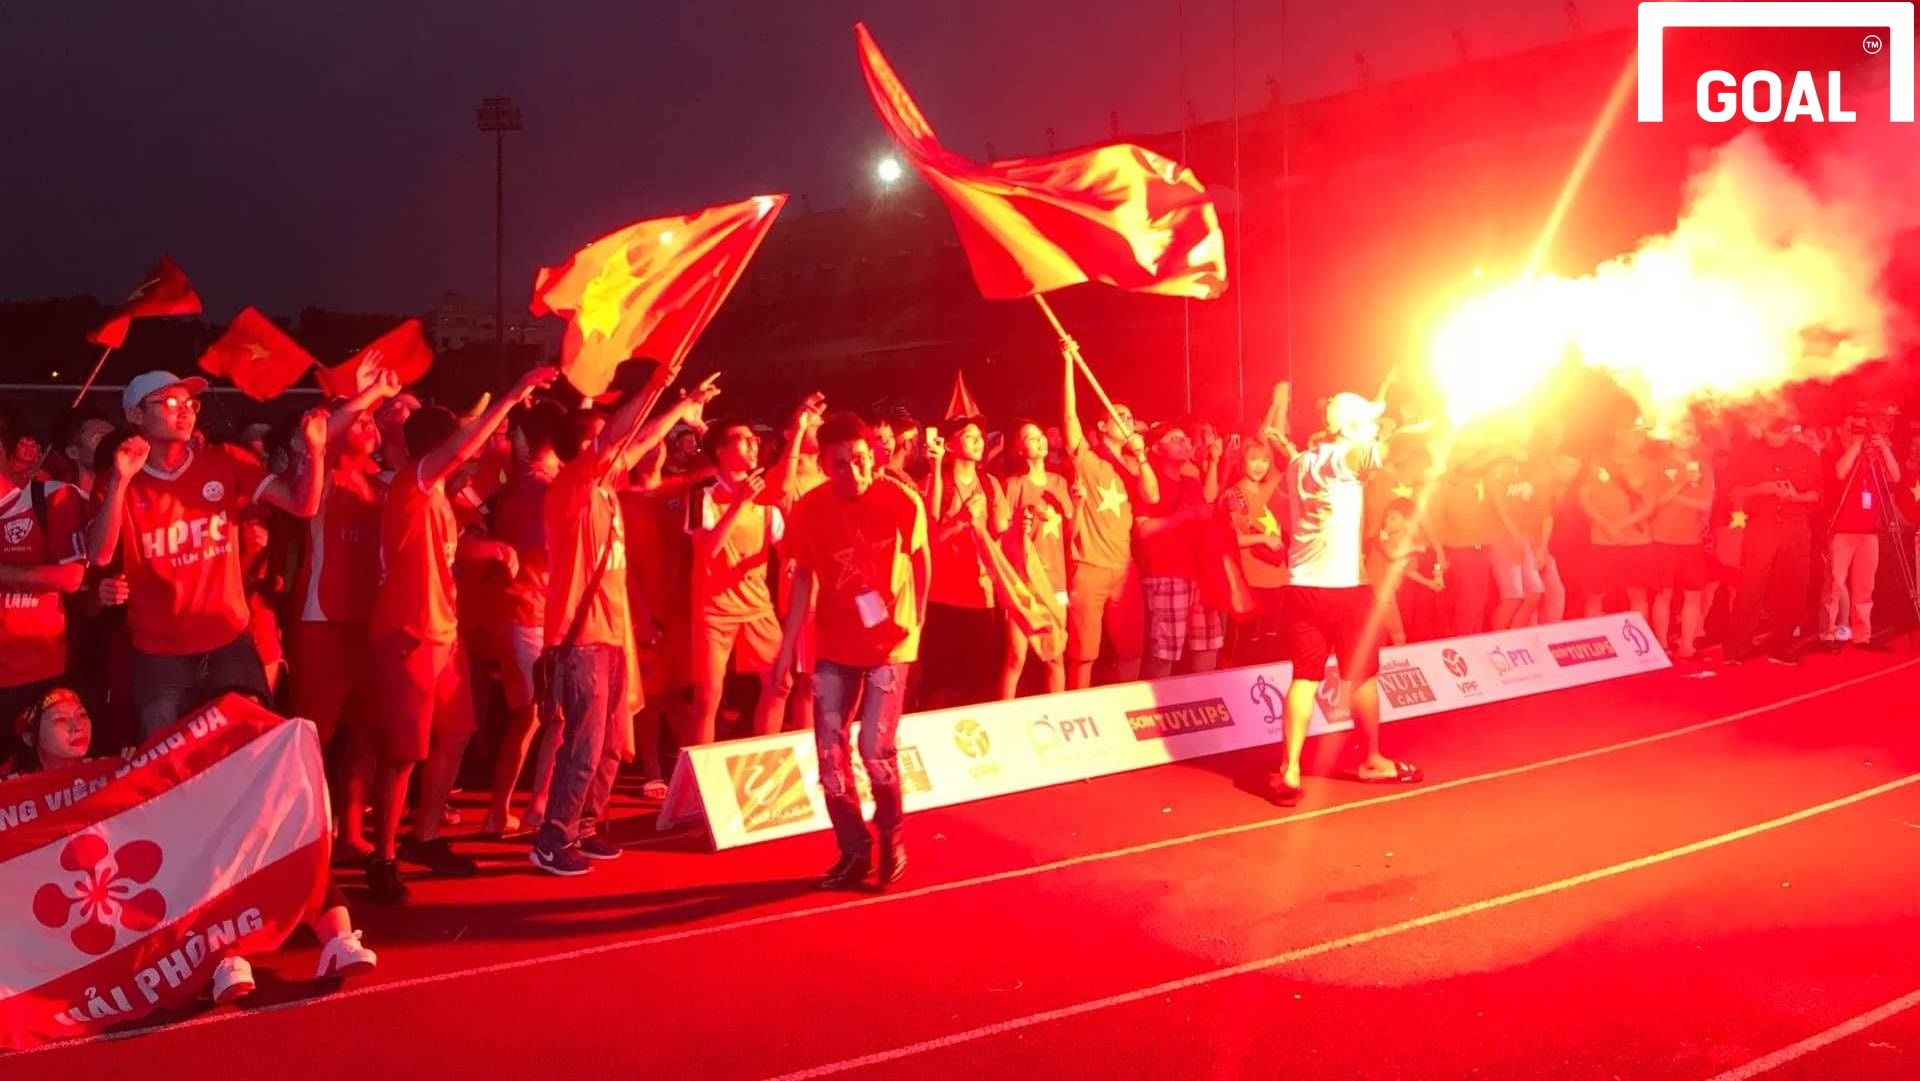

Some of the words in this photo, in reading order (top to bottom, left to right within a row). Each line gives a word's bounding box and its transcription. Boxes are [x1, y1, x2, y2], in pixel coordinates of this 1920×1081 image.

[142, 510, 228, 559] HPFC
[1507, 648, 1535, 668] PTI
[1058, 715, 1100, 742] PTI
[1153, 703, 1231, 731] TUYLIPS
[134, 907, 264, 1005] PHÒNG
